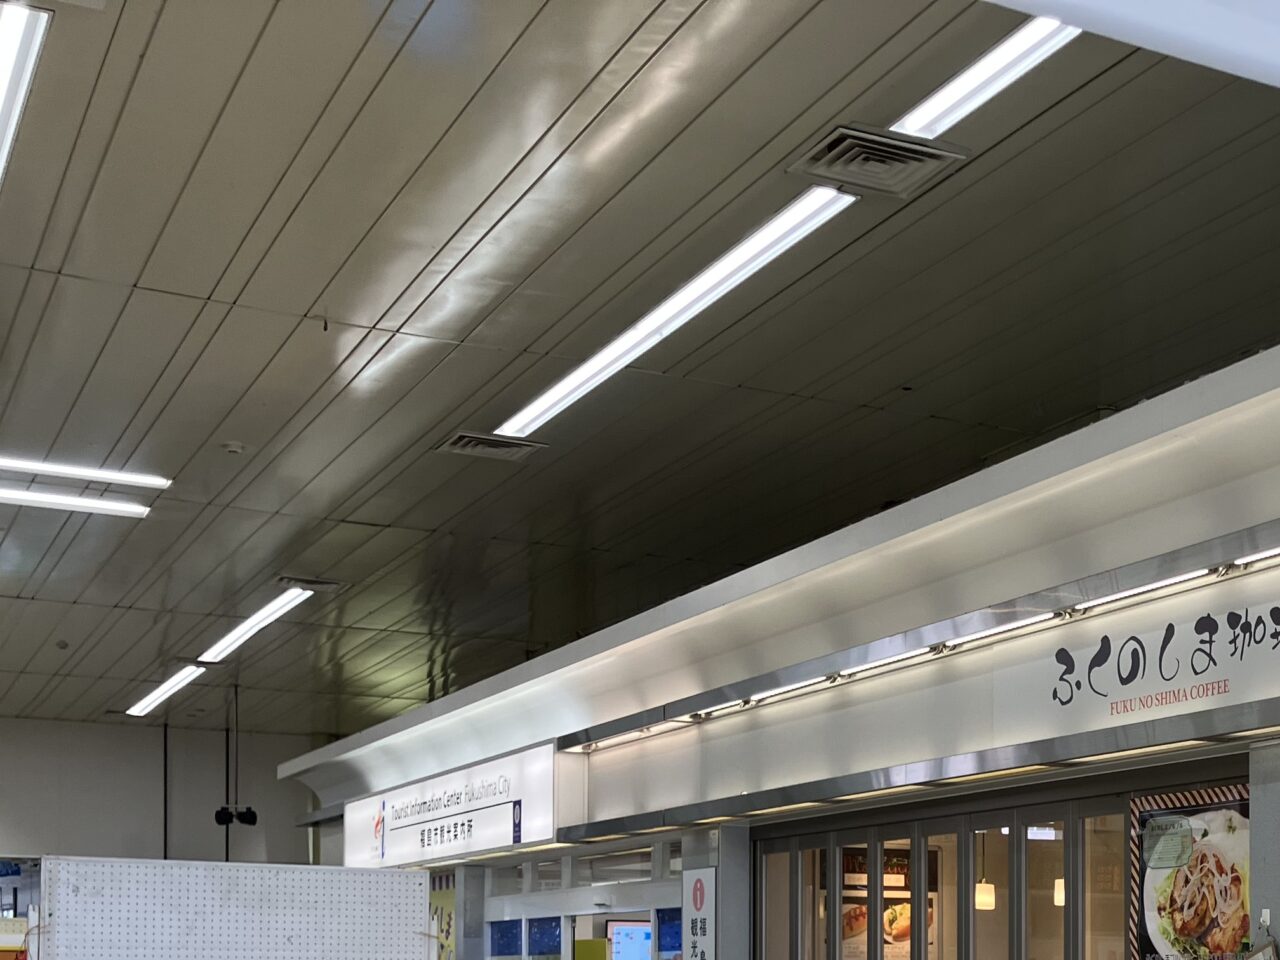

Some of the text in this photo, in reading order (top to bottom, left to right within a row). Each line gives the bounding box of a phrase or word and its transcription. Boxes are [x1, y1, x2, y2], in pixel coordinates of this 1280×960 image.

[1110, 679, 1231, 716] FUKU NO SHIMA COFFEE
[391, 774, 511, 821] Tourist Information Center Fukushima City
